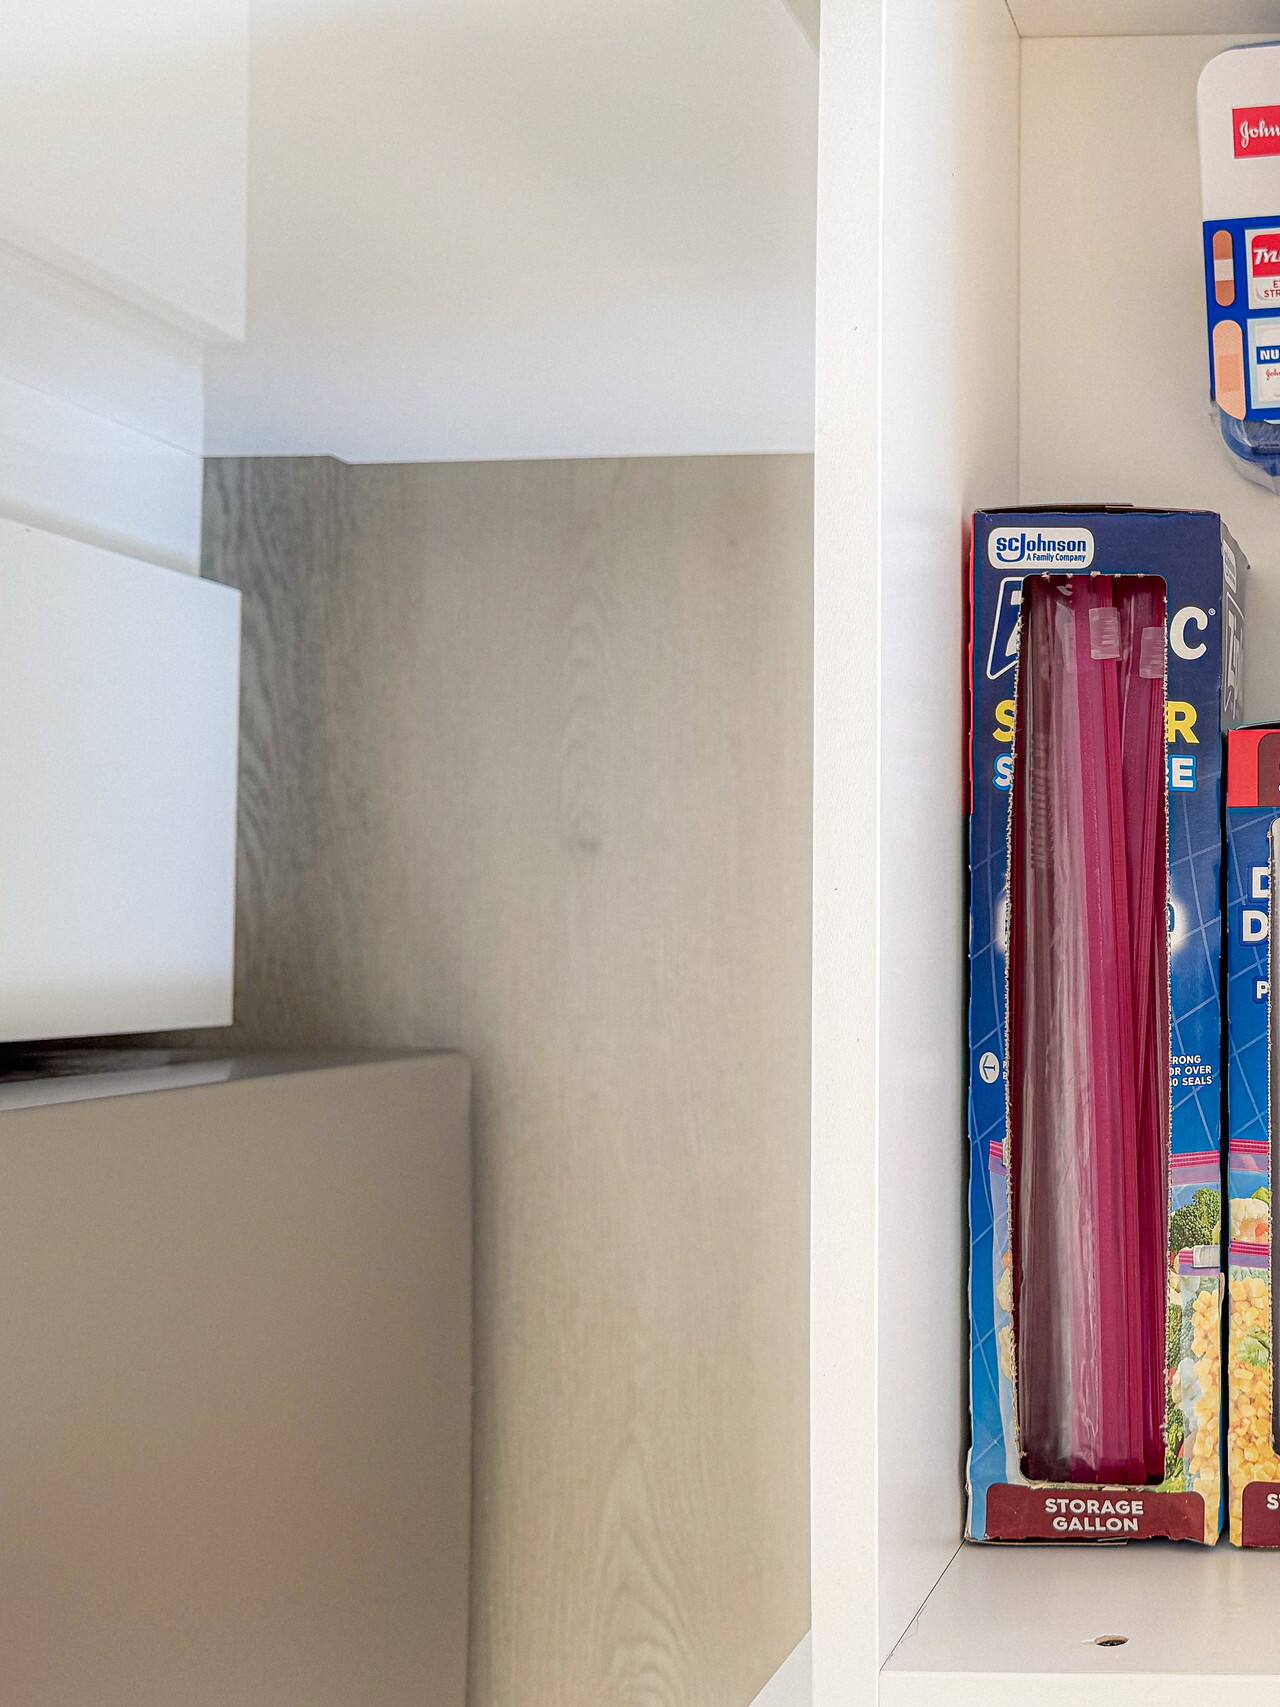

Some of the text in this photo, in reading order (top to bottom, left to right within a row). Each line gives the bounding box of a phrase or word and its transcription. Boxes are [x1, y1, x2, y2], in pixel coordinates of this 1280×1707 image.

[1260, 349, 1280, 360] NU
[1026, 553, 1086, 563] A Family Company
[1170, 1055, 1202, 1065] RONG
[1184, 1065, 1212, 1075] OVER
[1182, 1076, 1213, 1086] SEALS
[1045, 1498, 1144, 1516] STORAGE
[1052, 1516, 1139, 1533] GALLON
